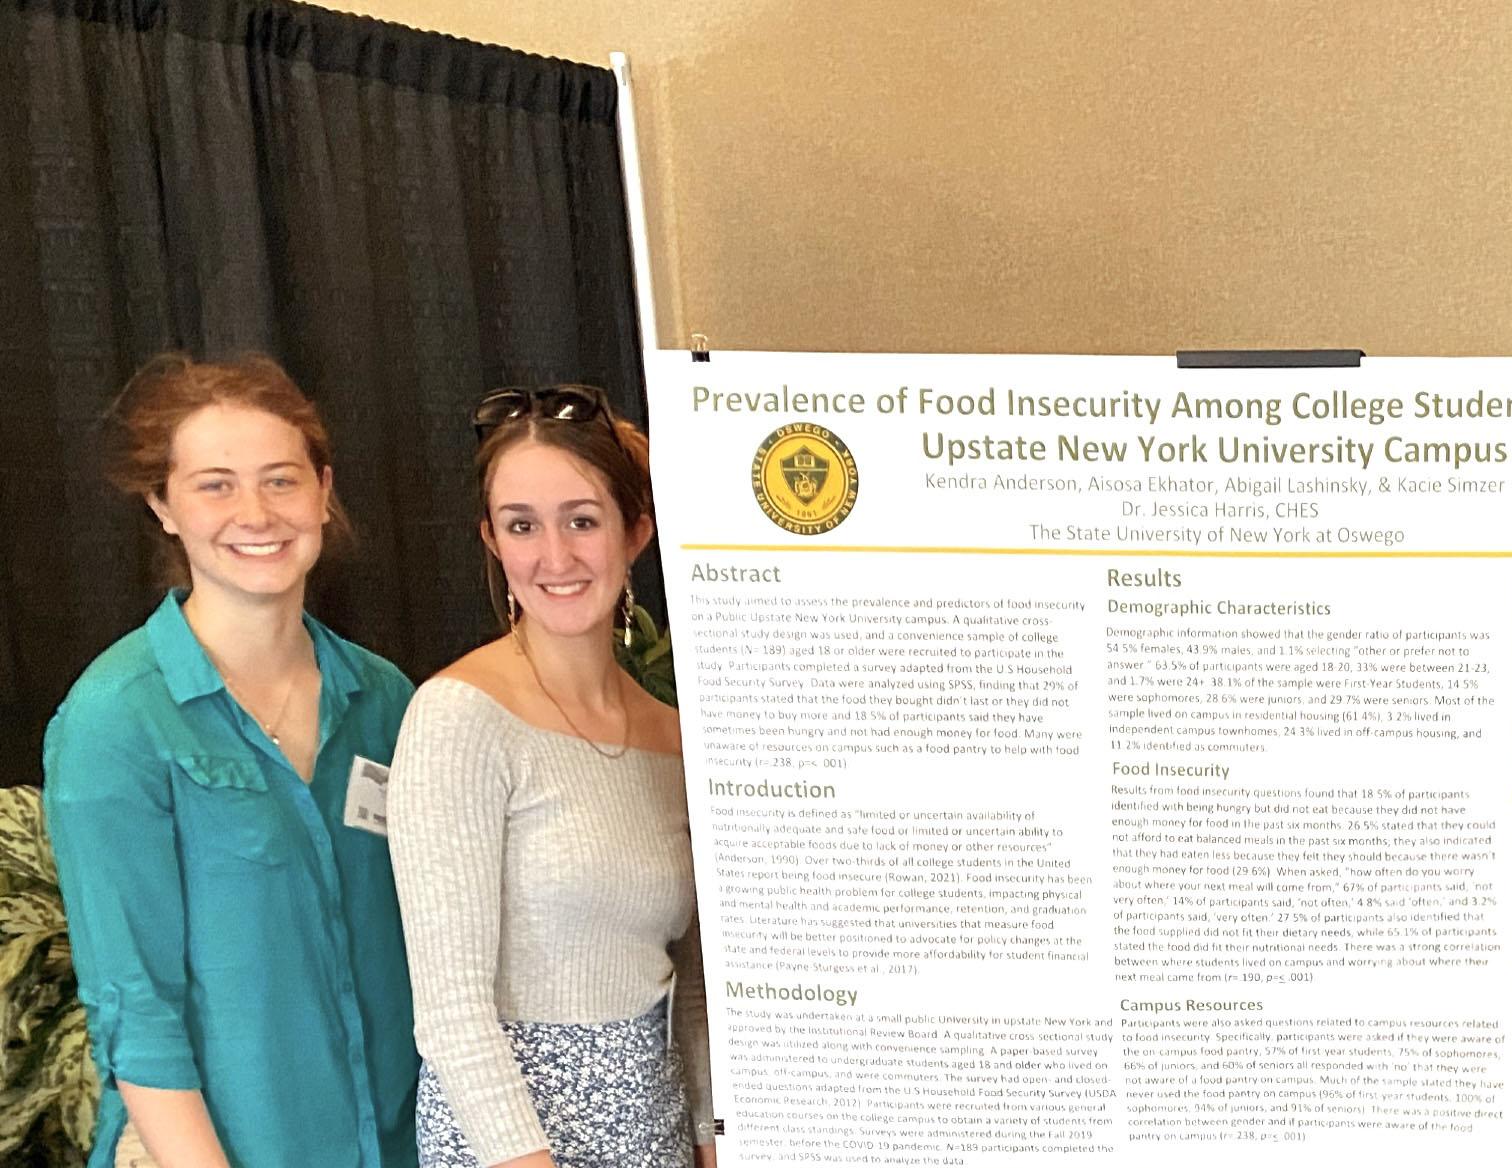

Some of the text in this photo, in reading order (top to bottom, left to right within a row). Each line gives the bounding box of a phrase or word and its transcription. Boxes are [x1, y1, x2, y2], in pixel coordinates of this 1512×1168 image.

[693, 384, 866, 413] Prevalence
[876, 385, 909, 414] of
[919, 386, 996, 416] Food
[1007, 388, 1162, 425] Insecurity
[1170, 391, 1282, 426] Among
[1292, 389, 1404, 426] College
[776, 423, 830, 438] OSWEGO
[922, 431, 1508, 471] Upstate New York University Campus
[752, 447, 858, 534] STATE UNIVERSITY OF NEW YORK
[925, 472, 1505, 497] Kendra Anderson, Aisosa Ekhator, Abigail Lashinsky, & Kacie Simzer
[1122, 500, 1319, 521] Dr. Jessica Harris, CHES
[1029, 522, 1405, 547] The State University of New York at Oswego
[691, 562, 782, 583] Abstract
[1107, 567, 1182, 588] Results
[1107, 598, 1331, 618] Demographic Characteristics
[1112, 760, 1230, 781] Food Insecurity
[708, 777, 836, 799] Introduction
[725, 980, 858, 1007] Methodology
[1120, 998, 1264, 1015] Campus Resources
